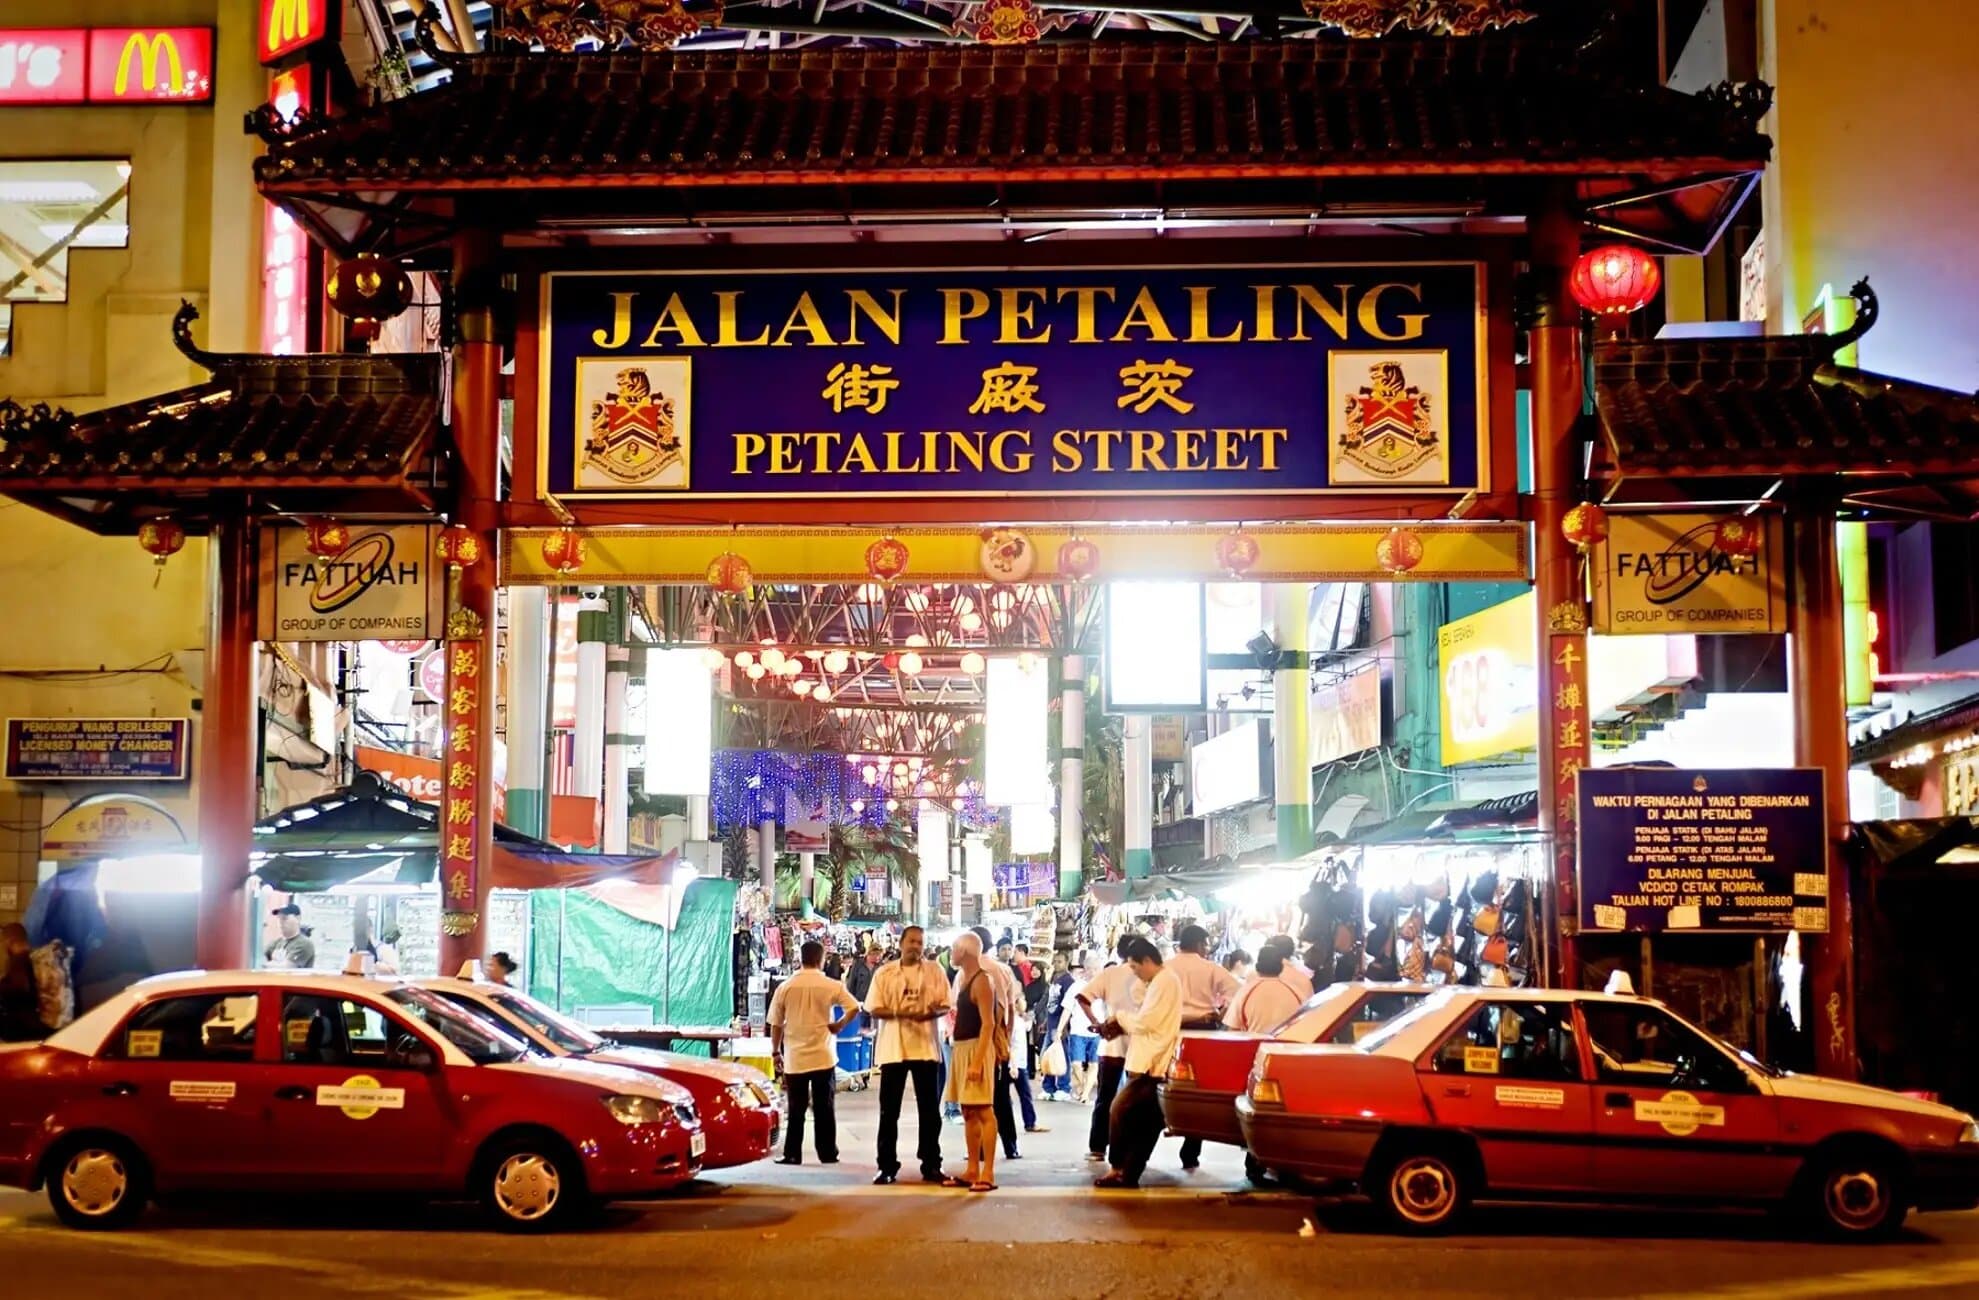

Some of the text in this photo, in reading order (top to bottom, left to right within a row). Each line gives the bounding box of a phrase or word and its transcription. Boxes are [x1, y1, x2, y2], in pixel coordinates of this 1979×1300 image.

[593, 283, 1428, 349] JALAN PETALING
[732, 428, 1287, 473] PETALING STREET
[1617, 552, 1758, 577] FATTUAH
[285, 562, 418, 587] FATTUAH
[1616, 607, 1764, 623] GROUP OF COMPANIES
[281, 616, 422, 631] GROUP OF COMPANIES
[82, 722, 114, 732] WANG
[20, 740, 173, 751] LICENSED MONEY CHANGER
[381, 771, 440, 796] ote
[1593, 796, 1809, 807] WAKTU PERNIAGAAN YANG DIBENARKAN
[1647, 809, 1752, 820] DI JALAN PETALING
[1648, 868, 1756, 879] DILARANG MENJUAL
[1639, 881, 1765, 893] VCD/CD CETAK ROMPAK
[1611, 895, 1649, 906] TALIAN
[1652, 895, 1675, 906] HOT
[1679, 895, 1702, 906] LINE
[1705, 895, 1722, 906] NO
[1734, 895, 1793, 906] 1800886800
